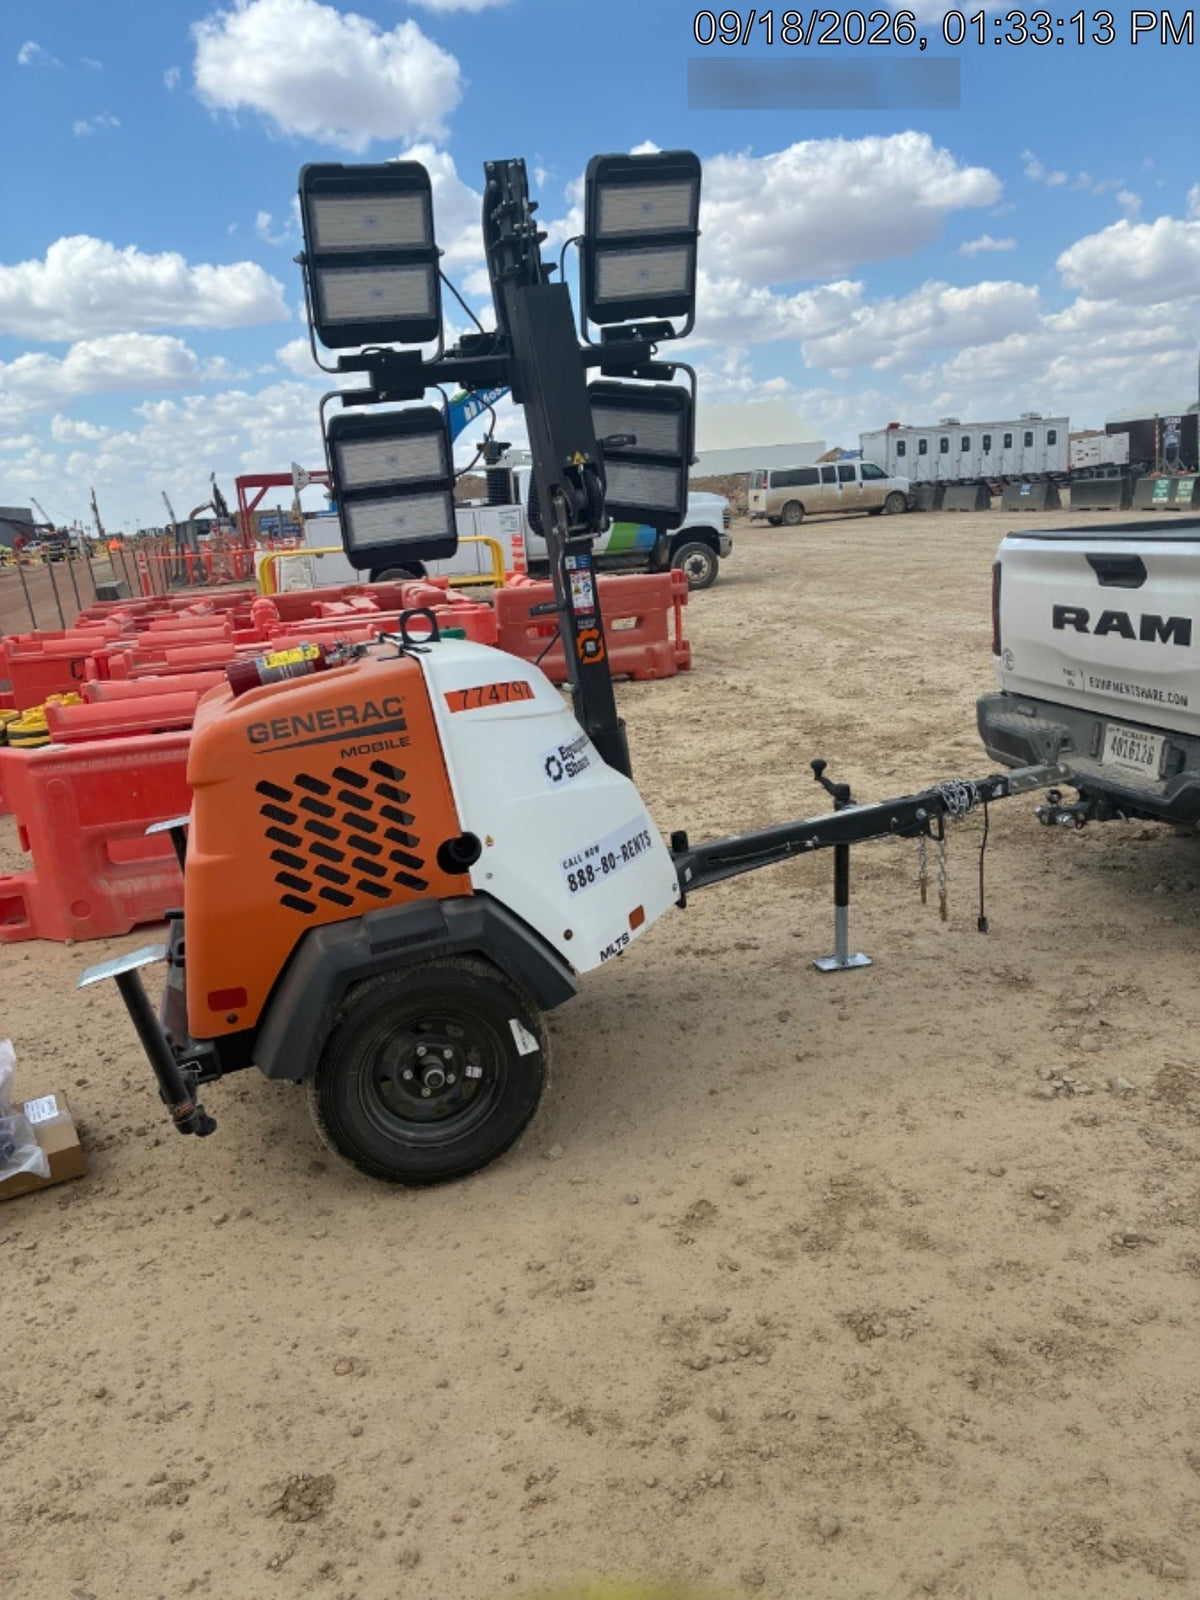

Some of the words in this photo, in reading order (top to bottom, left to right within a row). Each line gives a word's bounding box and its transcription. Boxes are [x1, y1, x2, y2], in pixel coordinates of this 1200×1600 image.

[1052, 604, 1193, 647] RAM
[246, 696, 405, 744] GENERAC
[339, 735, 412, 759] MOBILE
[562, 854, 583, 870] CALL
[584, 844, 600, 858] NOW
[567, 829, 652, 893] 888-80-RENTS
[600, 932, 631, 963] MLTS
